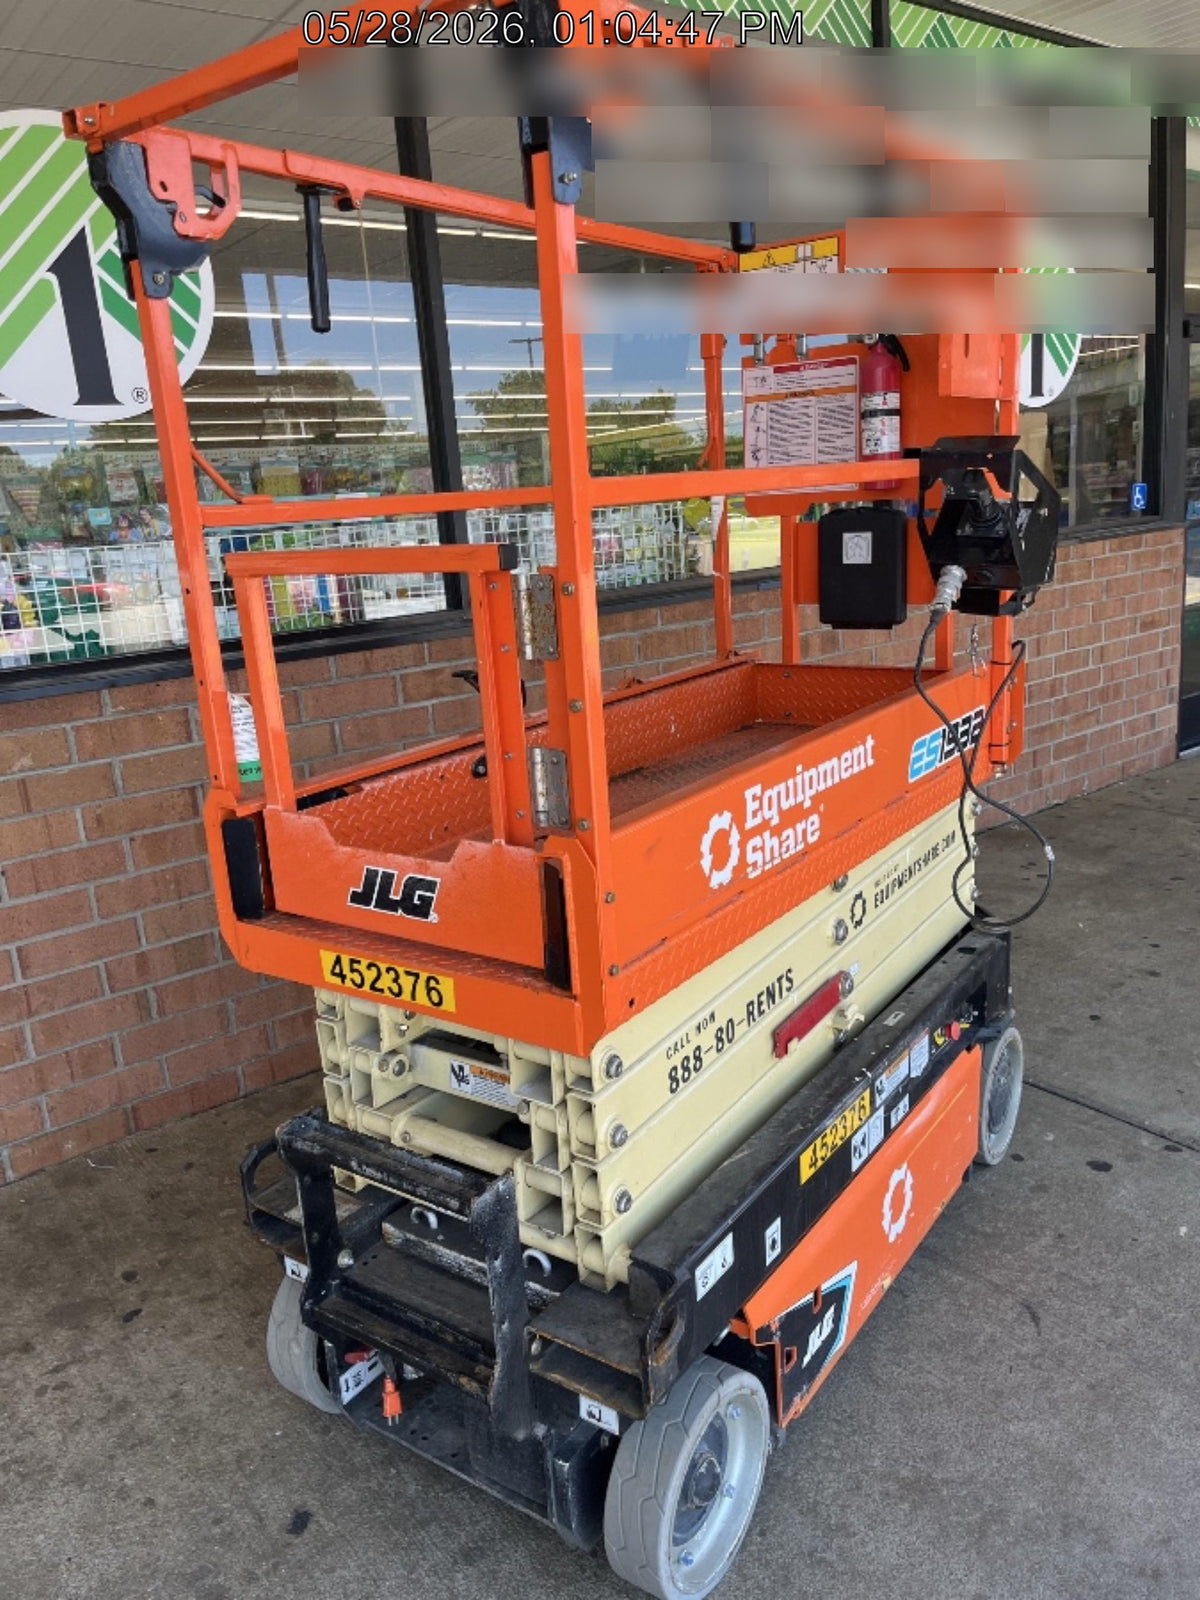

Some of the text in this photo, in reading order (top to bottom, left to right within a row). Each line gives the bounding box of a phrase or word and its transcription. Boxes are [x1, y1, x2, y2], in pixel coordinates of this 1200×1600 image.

[744, 734, 875, 832] Equipment
[746, 812, 821, 879] Share
[347, 865, 441, 921] JLG
[329, 953, 444, 1008] 452376
[666, 1032, 692, 1060] CALL
[667, 967, 795, 1094] 888-80-RENTS
[808, 1094, 867, 1171] 452376
